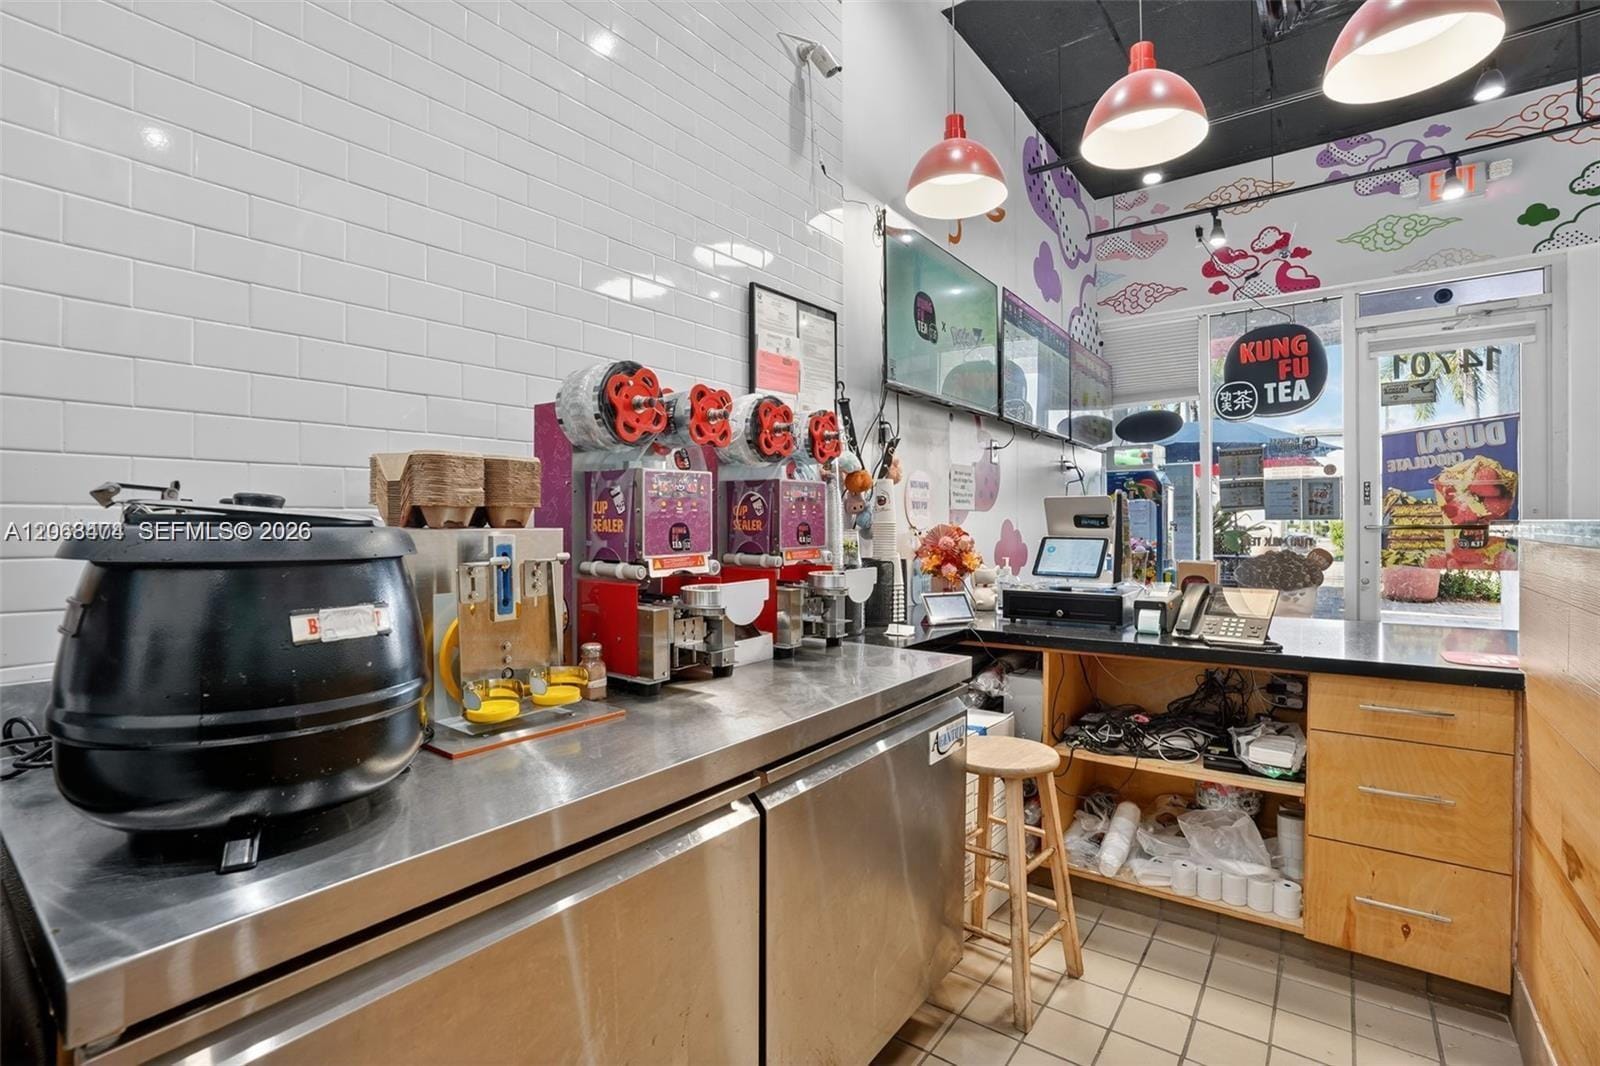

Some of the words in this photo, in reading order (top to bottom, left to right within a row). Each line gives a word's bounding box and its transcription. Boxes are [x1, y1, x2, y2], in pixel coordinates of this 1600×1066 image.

[1239, 334, 1309, 364] KUNG
[1278, 357, 1310, 380] FU
[1263, 380, 1310, 404] TEA
[592, 519, 624, 533] SEALER
